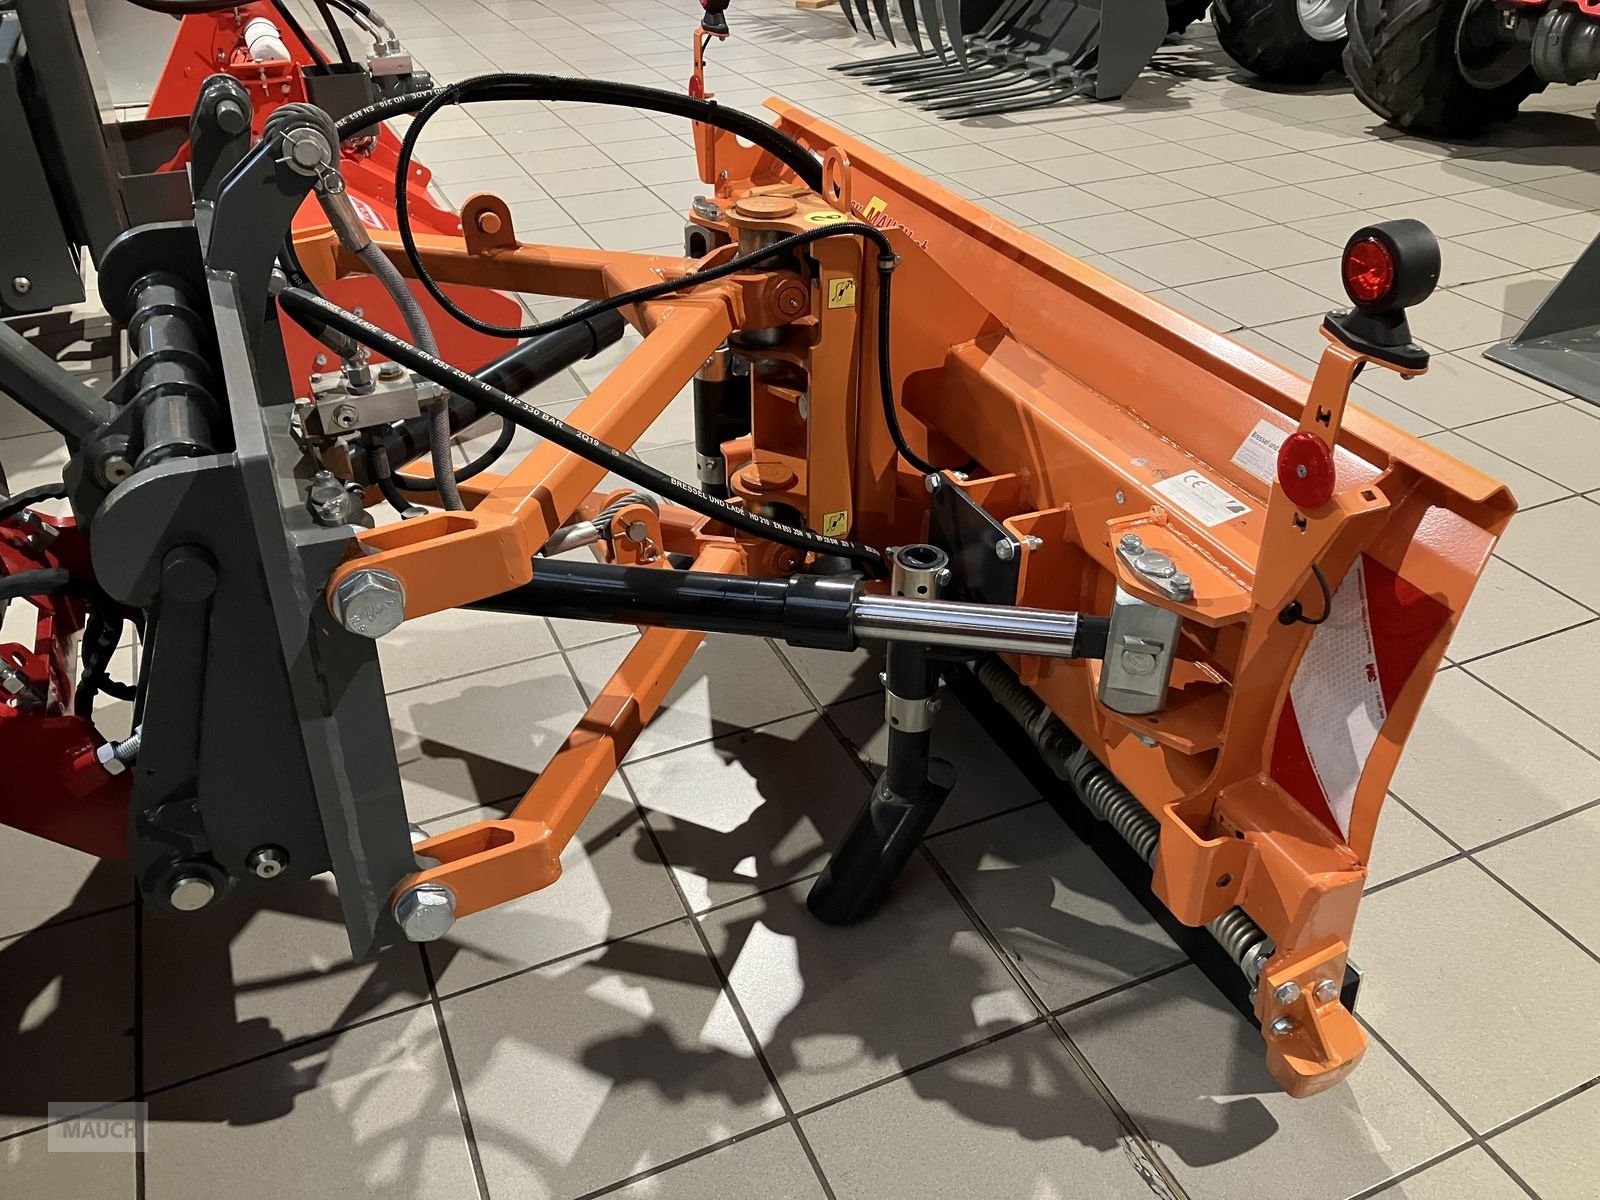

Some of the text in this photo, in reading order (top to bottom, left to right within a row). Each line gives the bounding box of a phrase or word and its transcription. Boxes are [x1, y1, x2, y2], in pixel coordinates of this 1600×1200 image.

[411, 90, 433, 100] LADE
[363, 105, 375, 113] EN
[379, 99, 393, 108] 210
[349, 111, 362, 120] 853
[356, 319, 380, 333] LADE
[383, 332, 397, 342] HD
[397, 340, 413, 350] 210
[418, 350, 432, 361] EN
[433, 359, 450, 370] 853
[452, 369, 473, 382] 2SN
[480, 382, 492, 392] 10
[503, 393, 521, 405] WP
[522, 402, 540, 416] 330
[541, 412, 564, 429] BAR
[575, 430, 600, 447] 2Q19
[1251, 431, 1269, 446] Bressel
[670, 478, 708, 500] BRESSEL
[708, 494, 725, 507] UND
[726, 503, 746, 516] LADE
[1365, 663, 1377, 683] 3M
